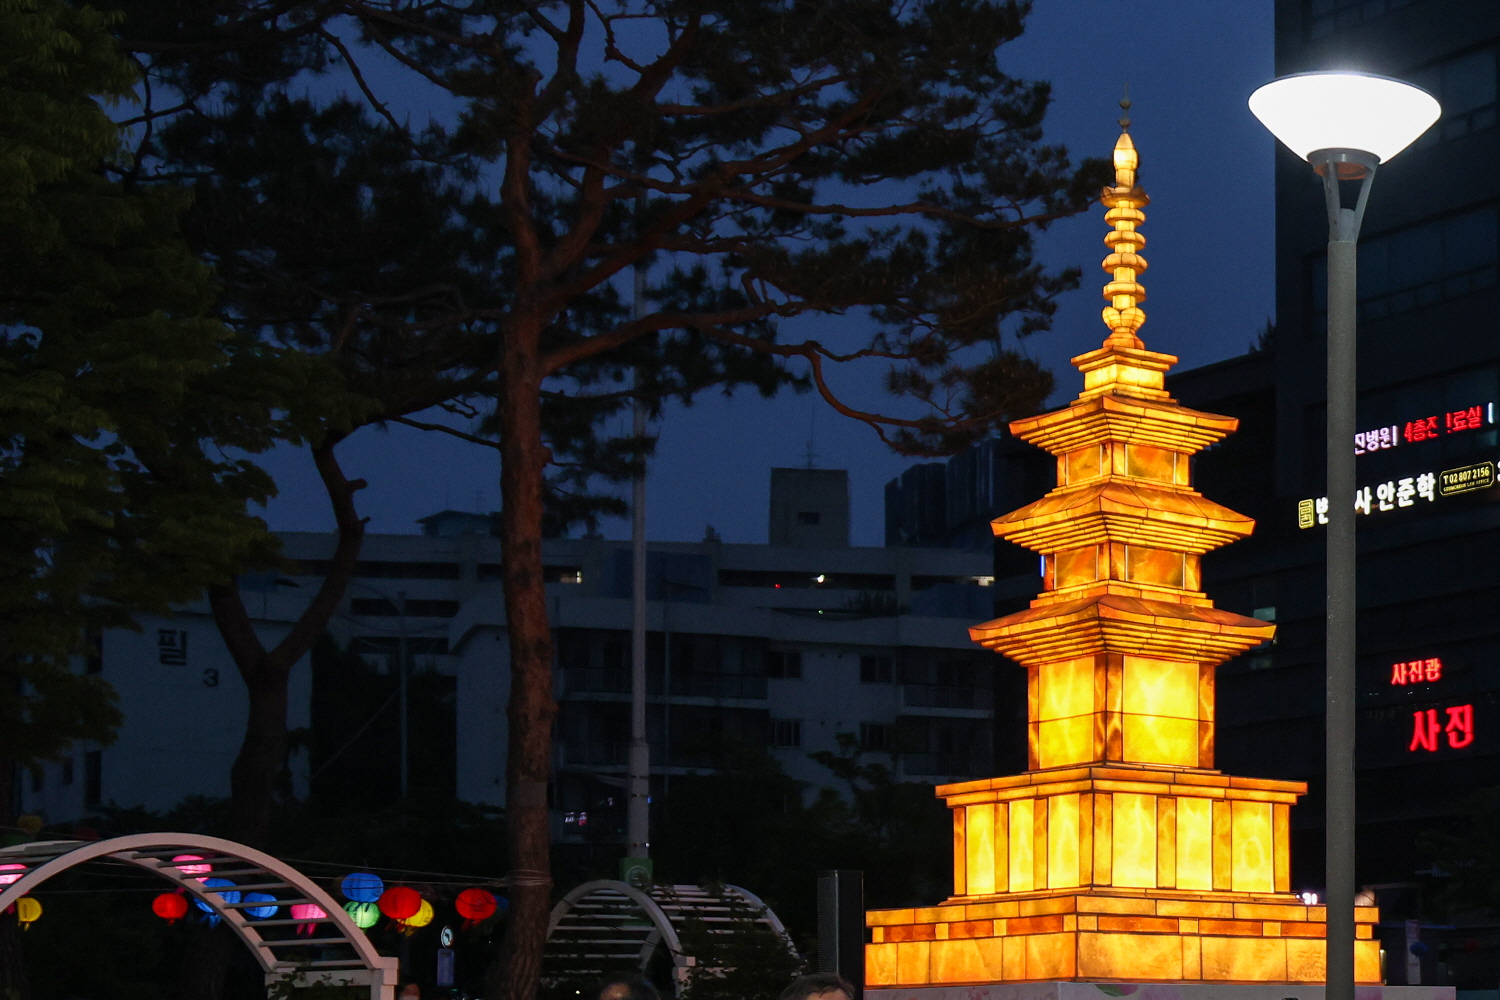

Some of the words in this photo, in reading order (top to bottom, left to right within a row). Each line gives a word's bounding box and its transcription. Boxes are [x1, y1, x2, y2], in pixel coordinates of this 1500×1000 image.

[1316, 486, 1372, 525] 변사
[1376, 472, 1436, 512] 안준학
[1391, 657, 1443, 686] 사진관
[1409, 703, 1475, 752] 사진
